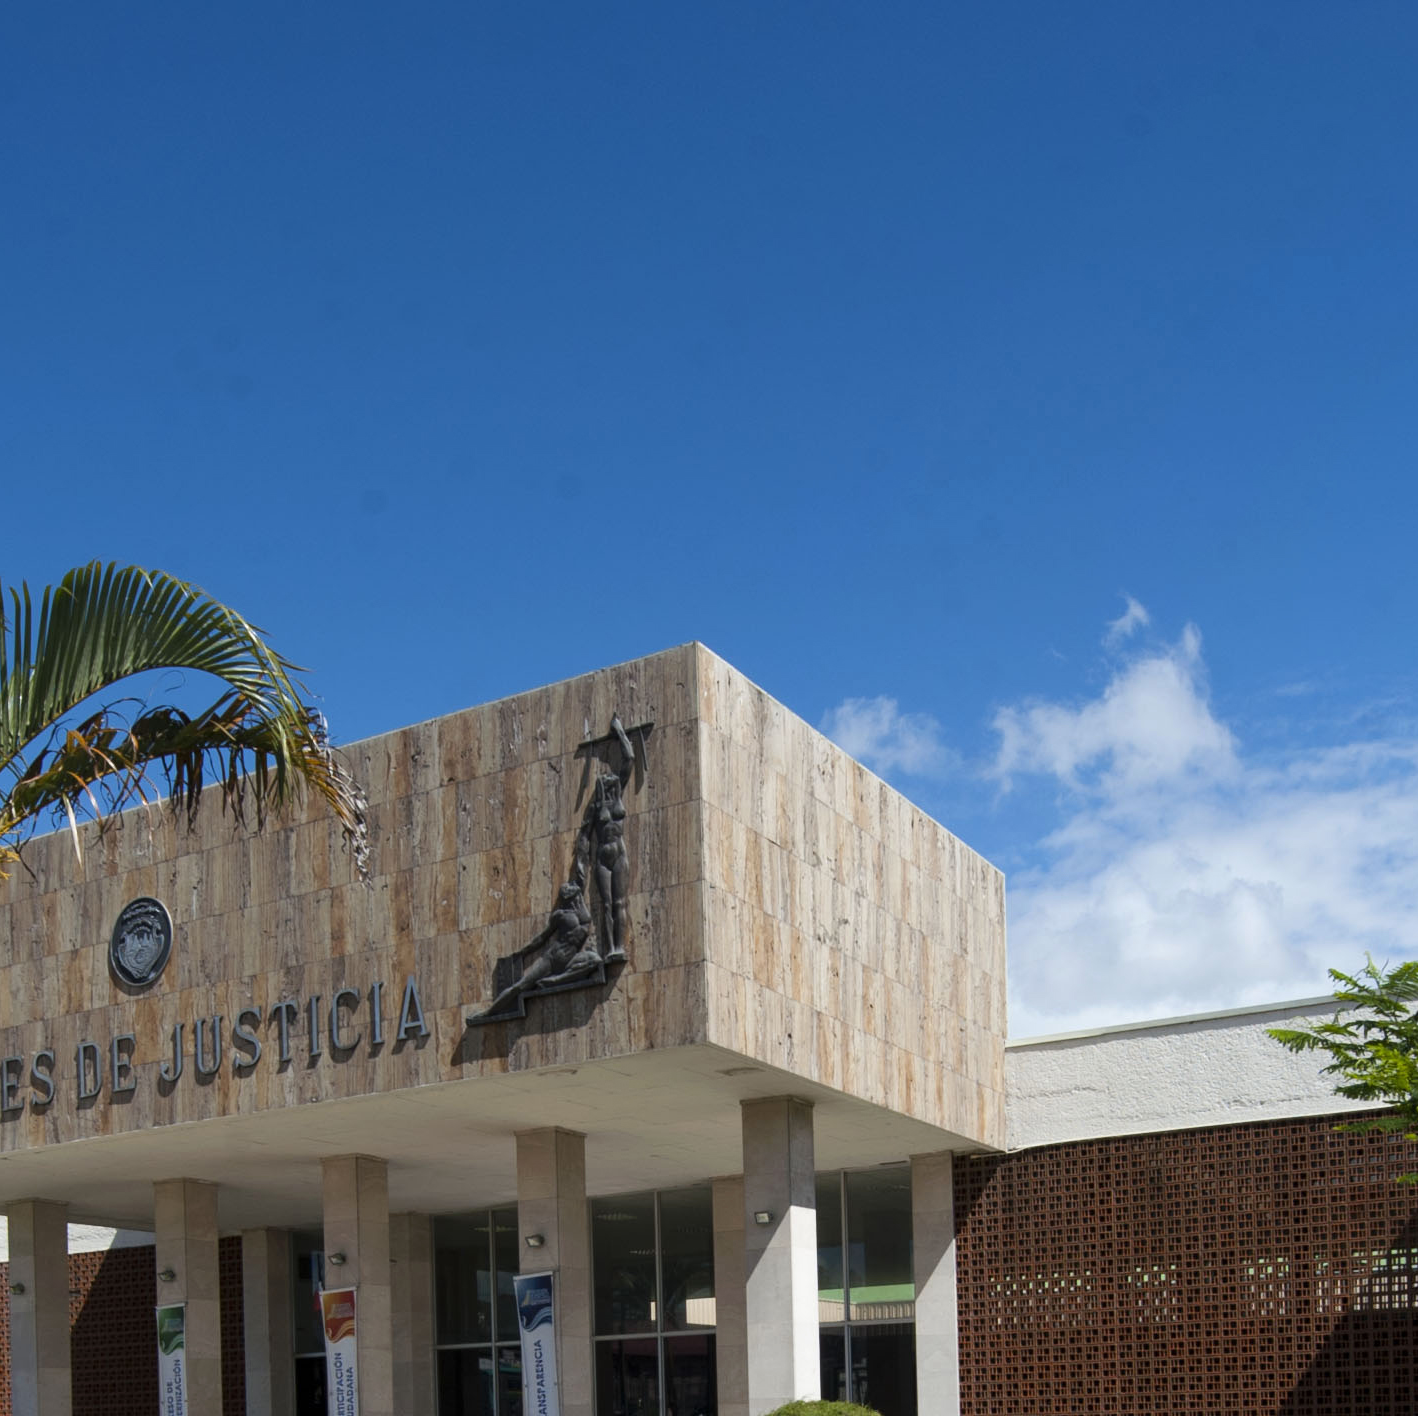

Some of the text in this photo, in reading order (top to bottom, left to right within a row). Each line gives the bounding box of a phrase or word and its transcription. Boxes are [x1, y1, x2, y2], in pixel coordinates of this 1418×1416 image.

[78, 1033, 136, 1098] DE
[160, 976, 430, 1082] JUSTICIA
[167, 1381, 173, 1393] DE
